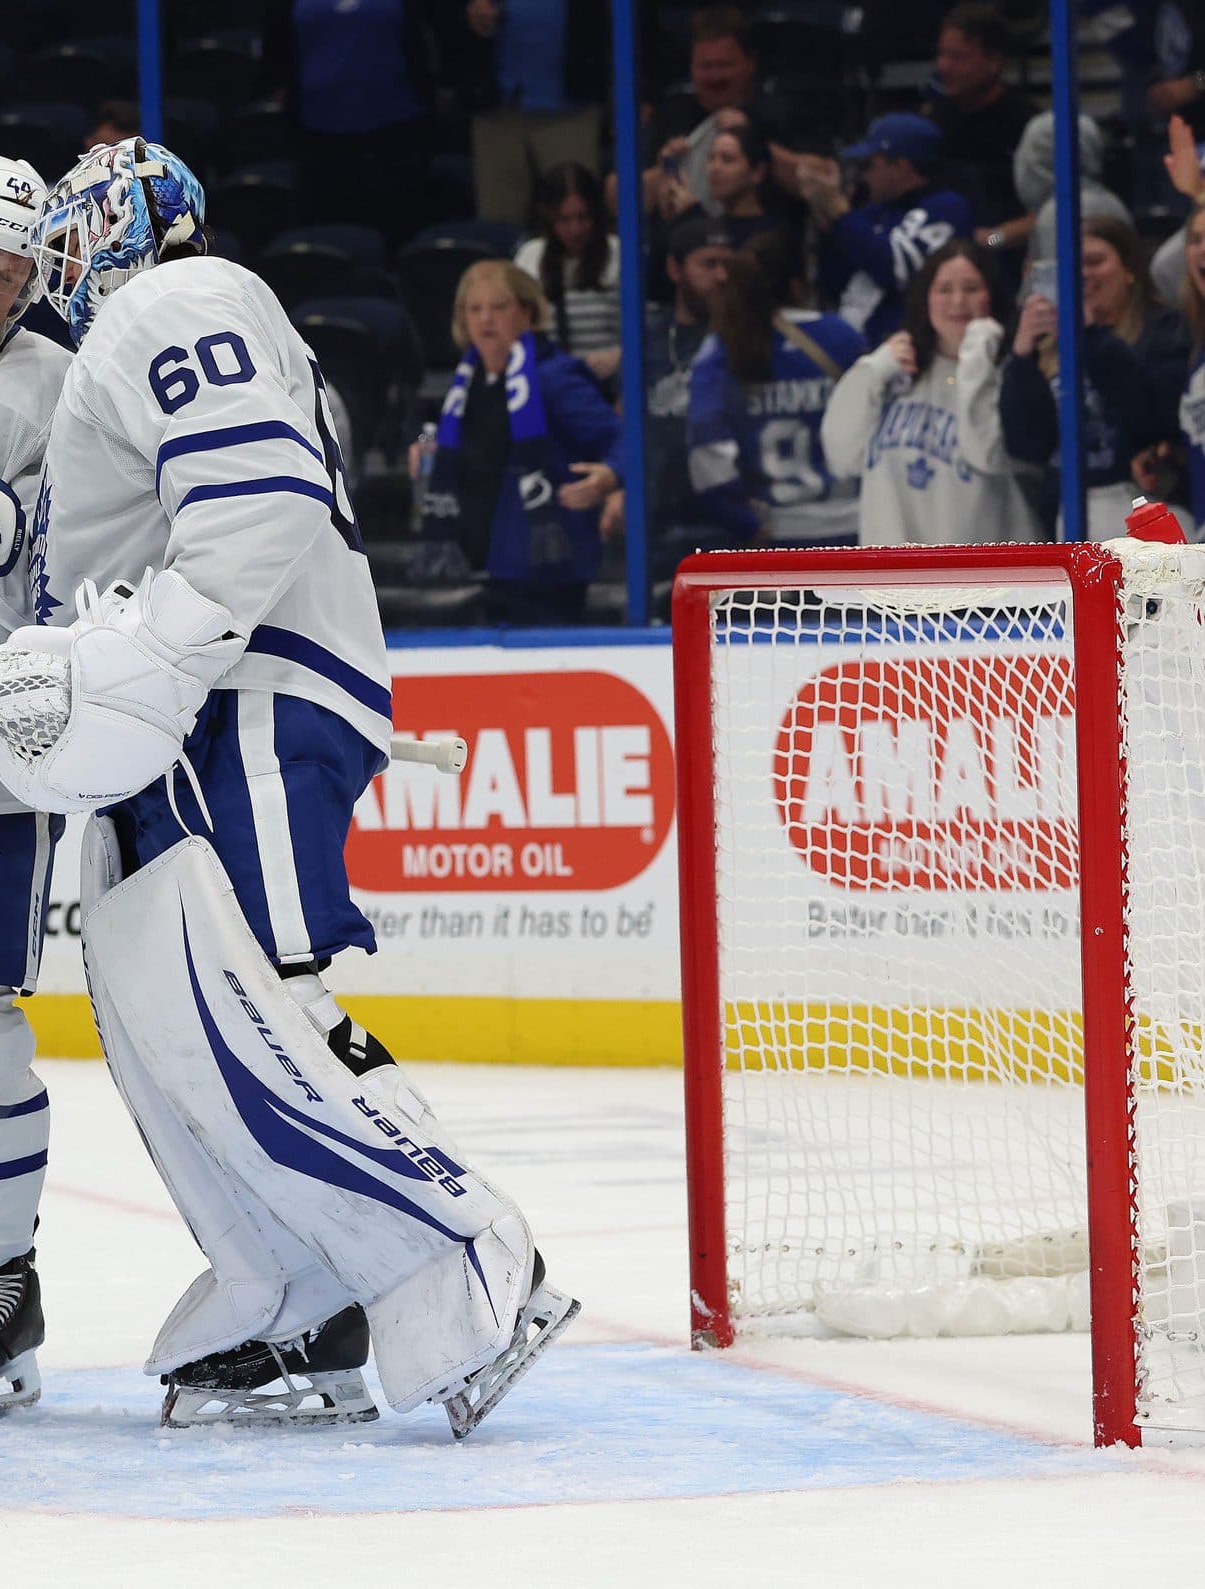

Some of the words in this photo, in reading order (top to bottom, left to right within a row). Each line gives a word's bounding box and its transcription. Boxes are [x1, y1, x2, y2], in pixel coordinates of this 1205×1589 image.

[148, 331, 257, 415] 60
[759, 418, 828, 503] 9
[402, 843, 514, 878] MOTOR
[520, 842, 575, 877] OIL
[420, 904, 484, 938] than
[494, 904, 512, 938] it
[518, 904, 572, 938] has
[580, 905, 608, 938] to
[222, 969, 324, 1102] BAUER
[351, 1095, 468, 1197] BAUER
